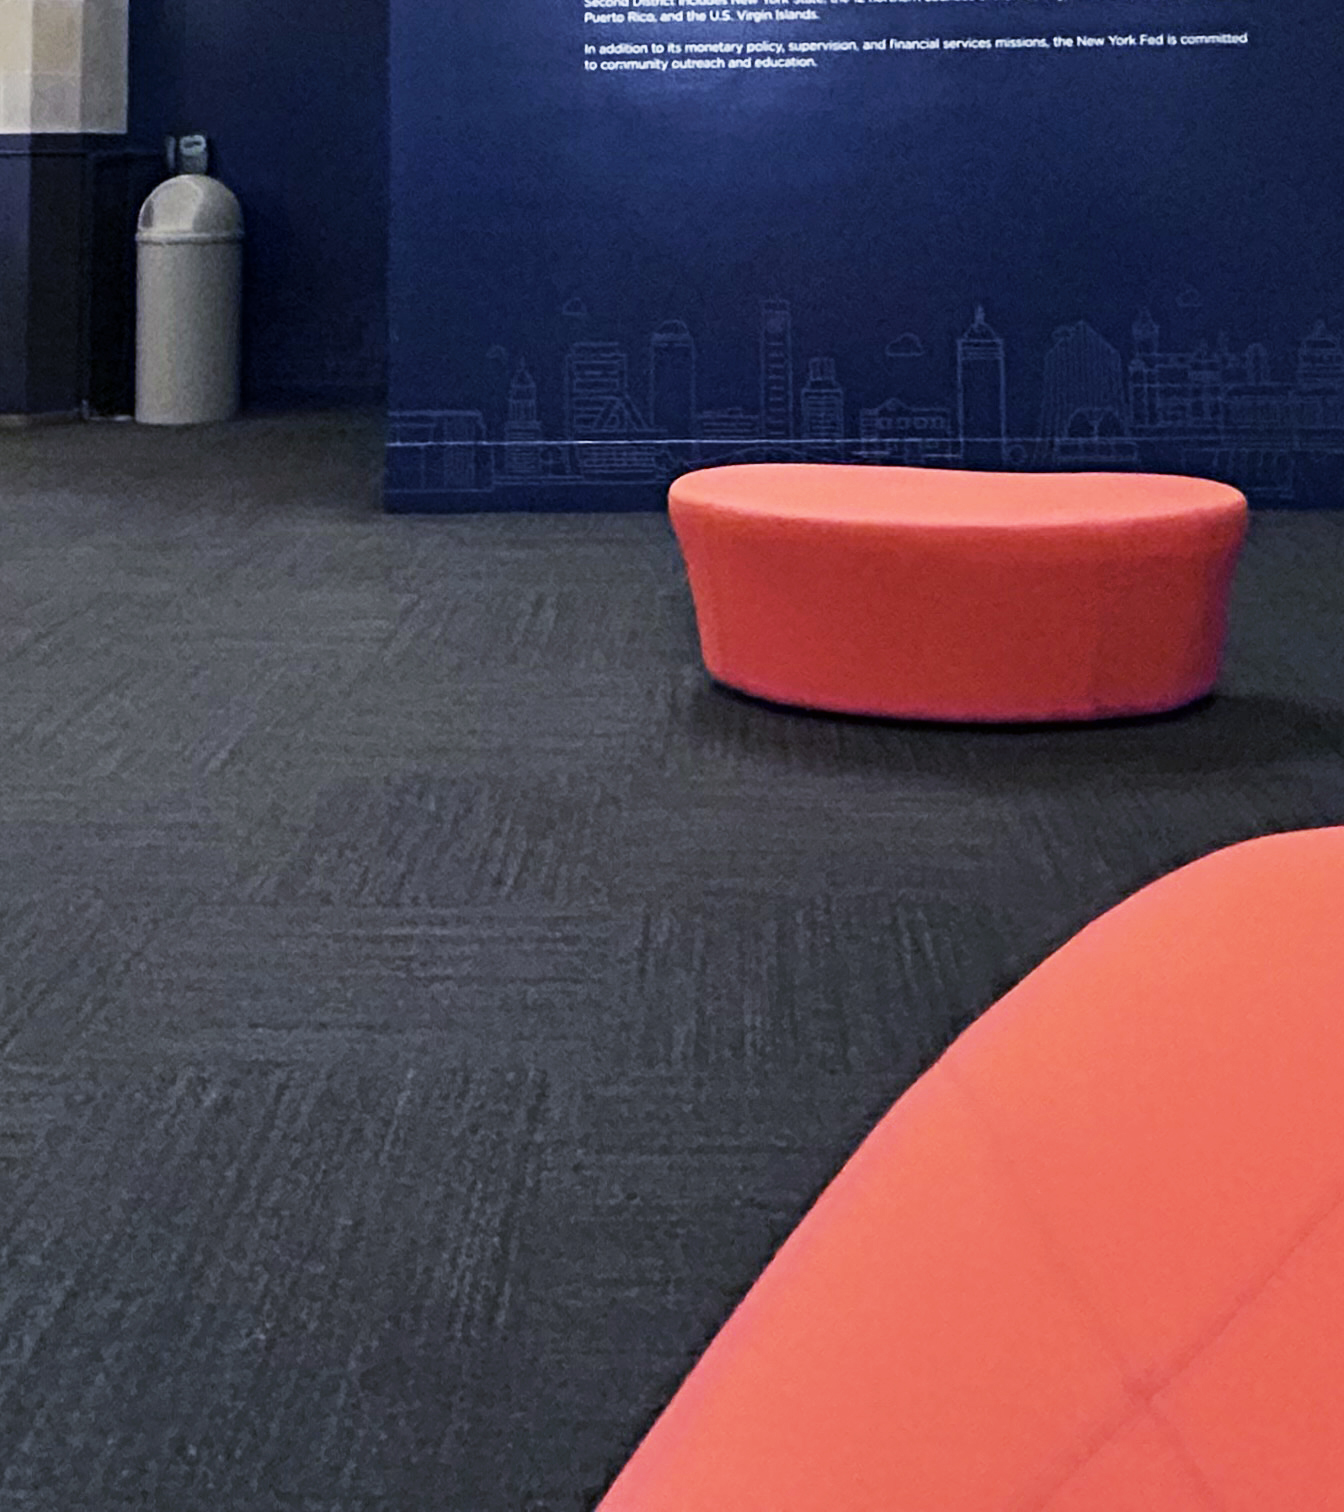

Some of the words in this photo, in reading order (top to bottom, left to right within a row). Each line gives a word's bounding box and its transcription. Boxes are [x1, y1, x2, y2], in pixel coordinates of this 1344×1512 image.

[583, 12, 626, 23] Puerto
[658, 10, 684, 22] and
[685, 10, 708, 22] the
[708, 9, 736, 22] U.S.
[735, 9, 774, 23] Virgin
[774, 9, 821, 21] Islands.
[583, 44, 597, 55] In
[598, 43, 649, 55] addition
[650, 43, 666, 54] to
[666, 42, 683, 54] its
[683, 42, 744, 55] monetary
[861, 39, 887, 50] and
[889, 38, 941, 50] financial
[942, 37, 993, 49] services
[1052, 36, 1075, 47] the
[1076, 35, 1106, 47] New
[1106, 34, 1138, 46] York
[1138, 33, 1165, 46] Fed
[1166, 34, 1178, 46] is
[1179, 32, 1249, 45] committed
[583, 60, 599, 71] to
[599, 58, 670, 71] community
[670, 57, 726, 69] outreach
[727, 56, 753, 68] and
[753, 56, 819, 68] education.
